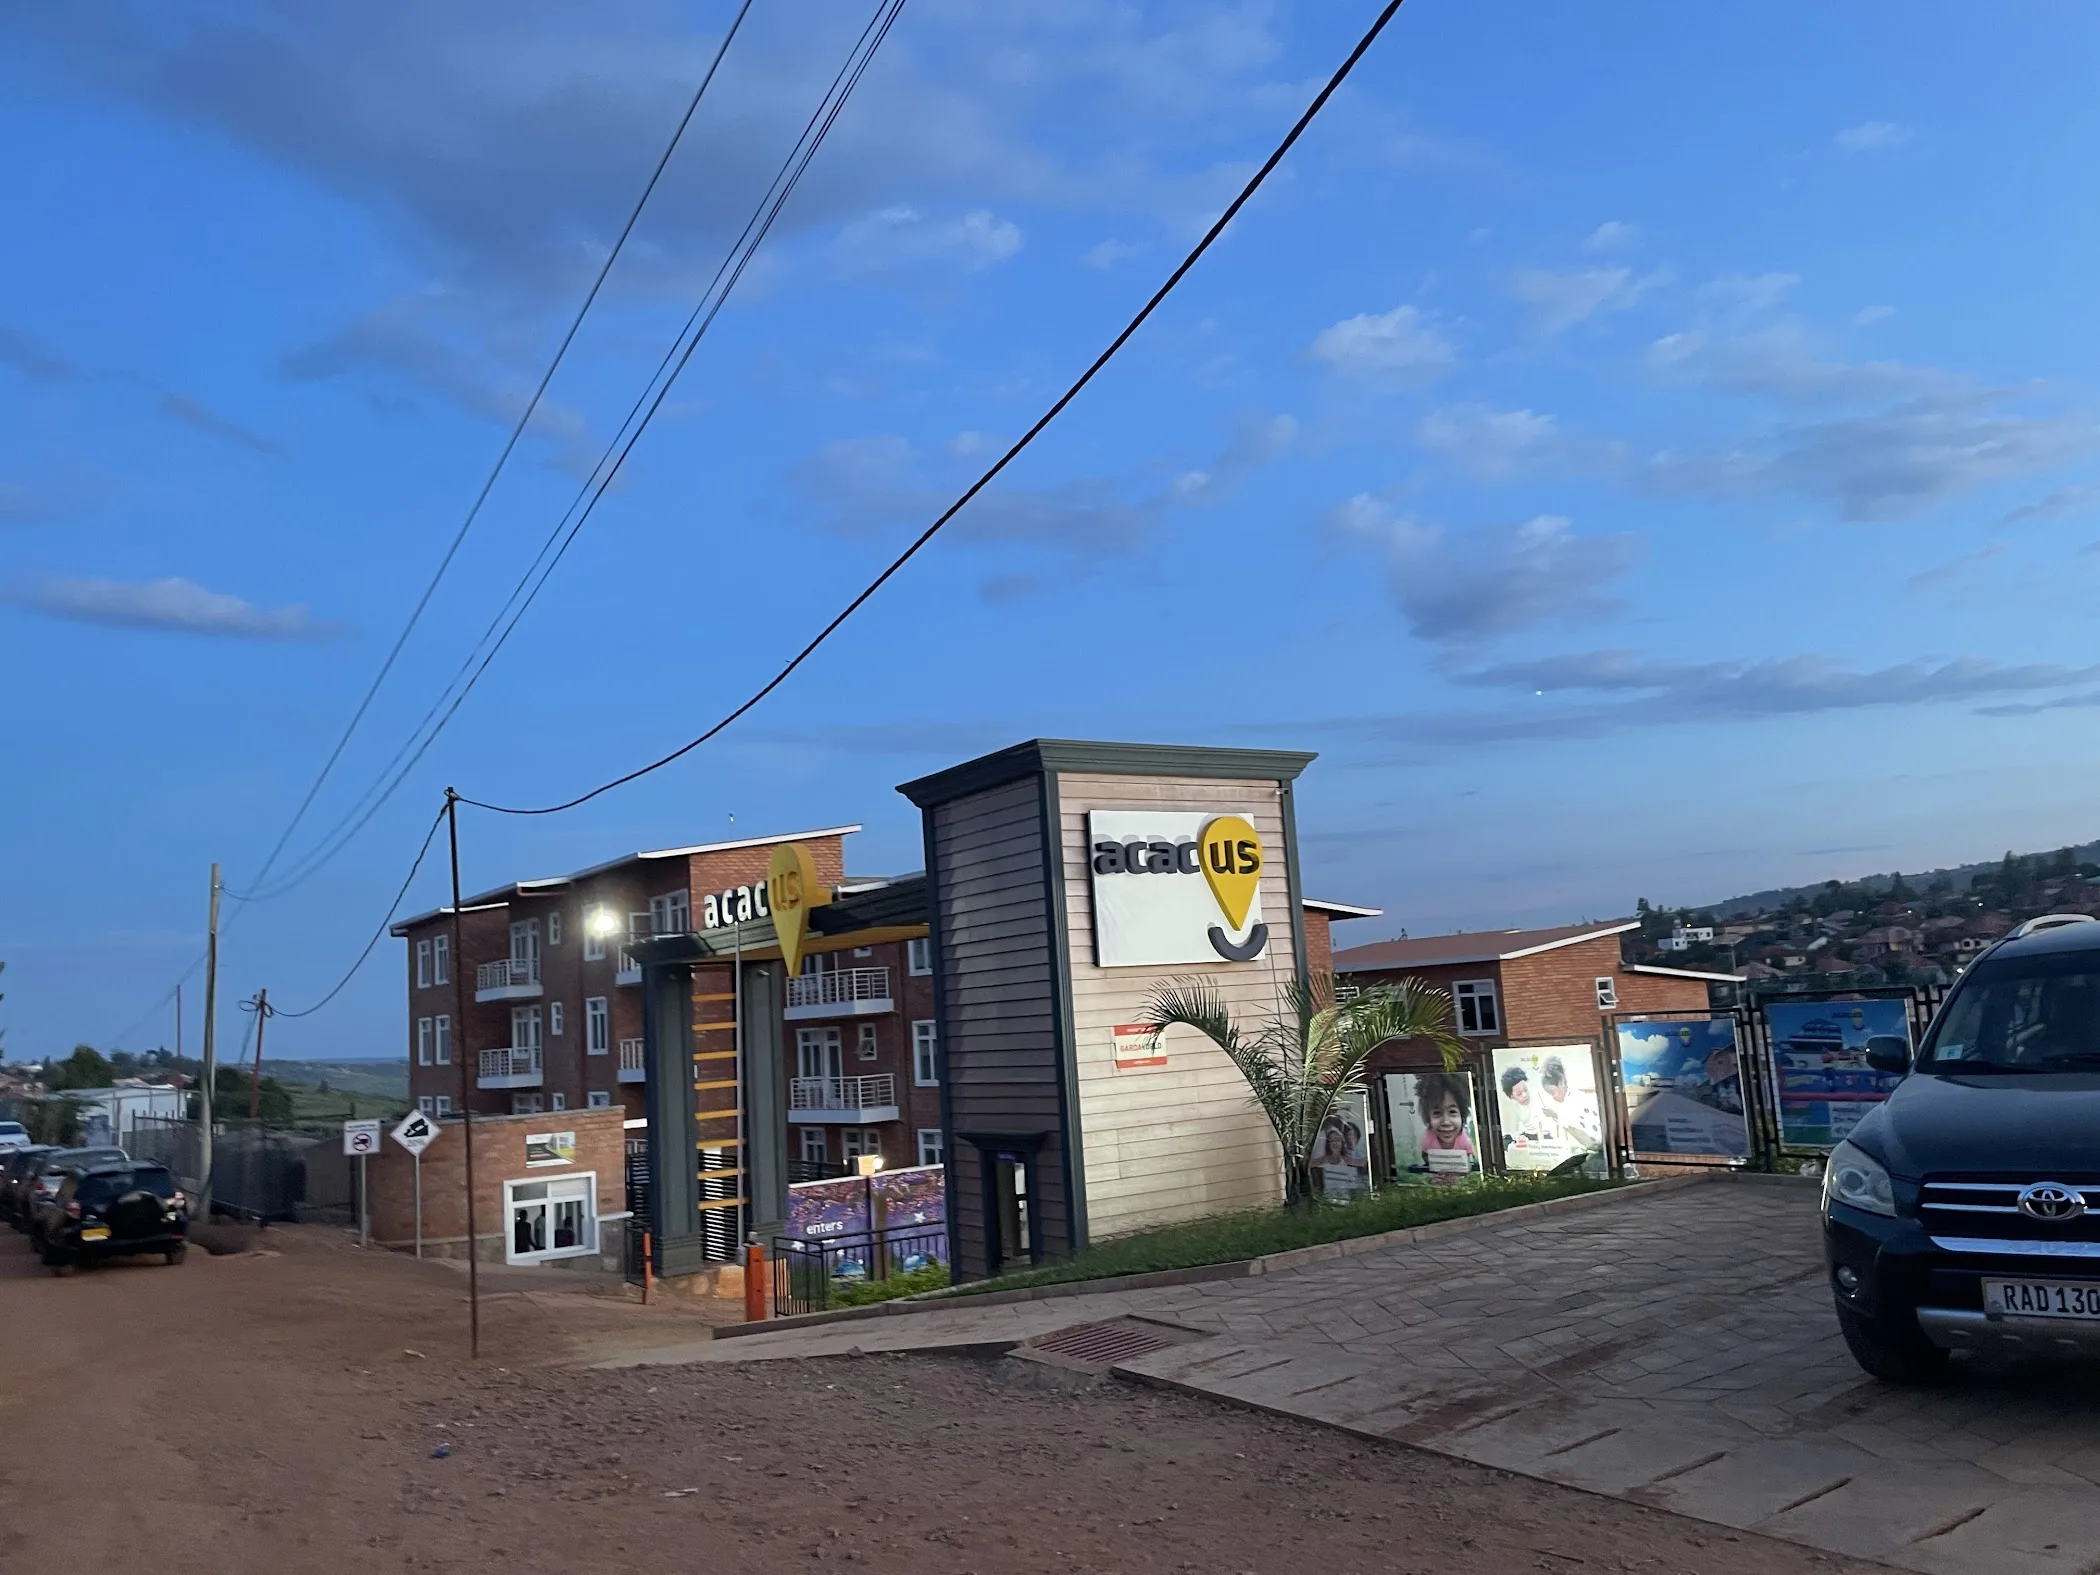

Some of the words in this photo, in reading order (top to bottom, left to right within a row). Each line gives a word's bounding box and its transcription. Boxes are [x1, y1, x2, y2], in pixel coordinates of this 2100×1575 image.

[1094, 839, 1259, 875] acacus
[806, 1221, 844, 1235] enters
[2003, 1284, 2050, 1312] RAD
[2055, 1287, 2100, 1315] 130
